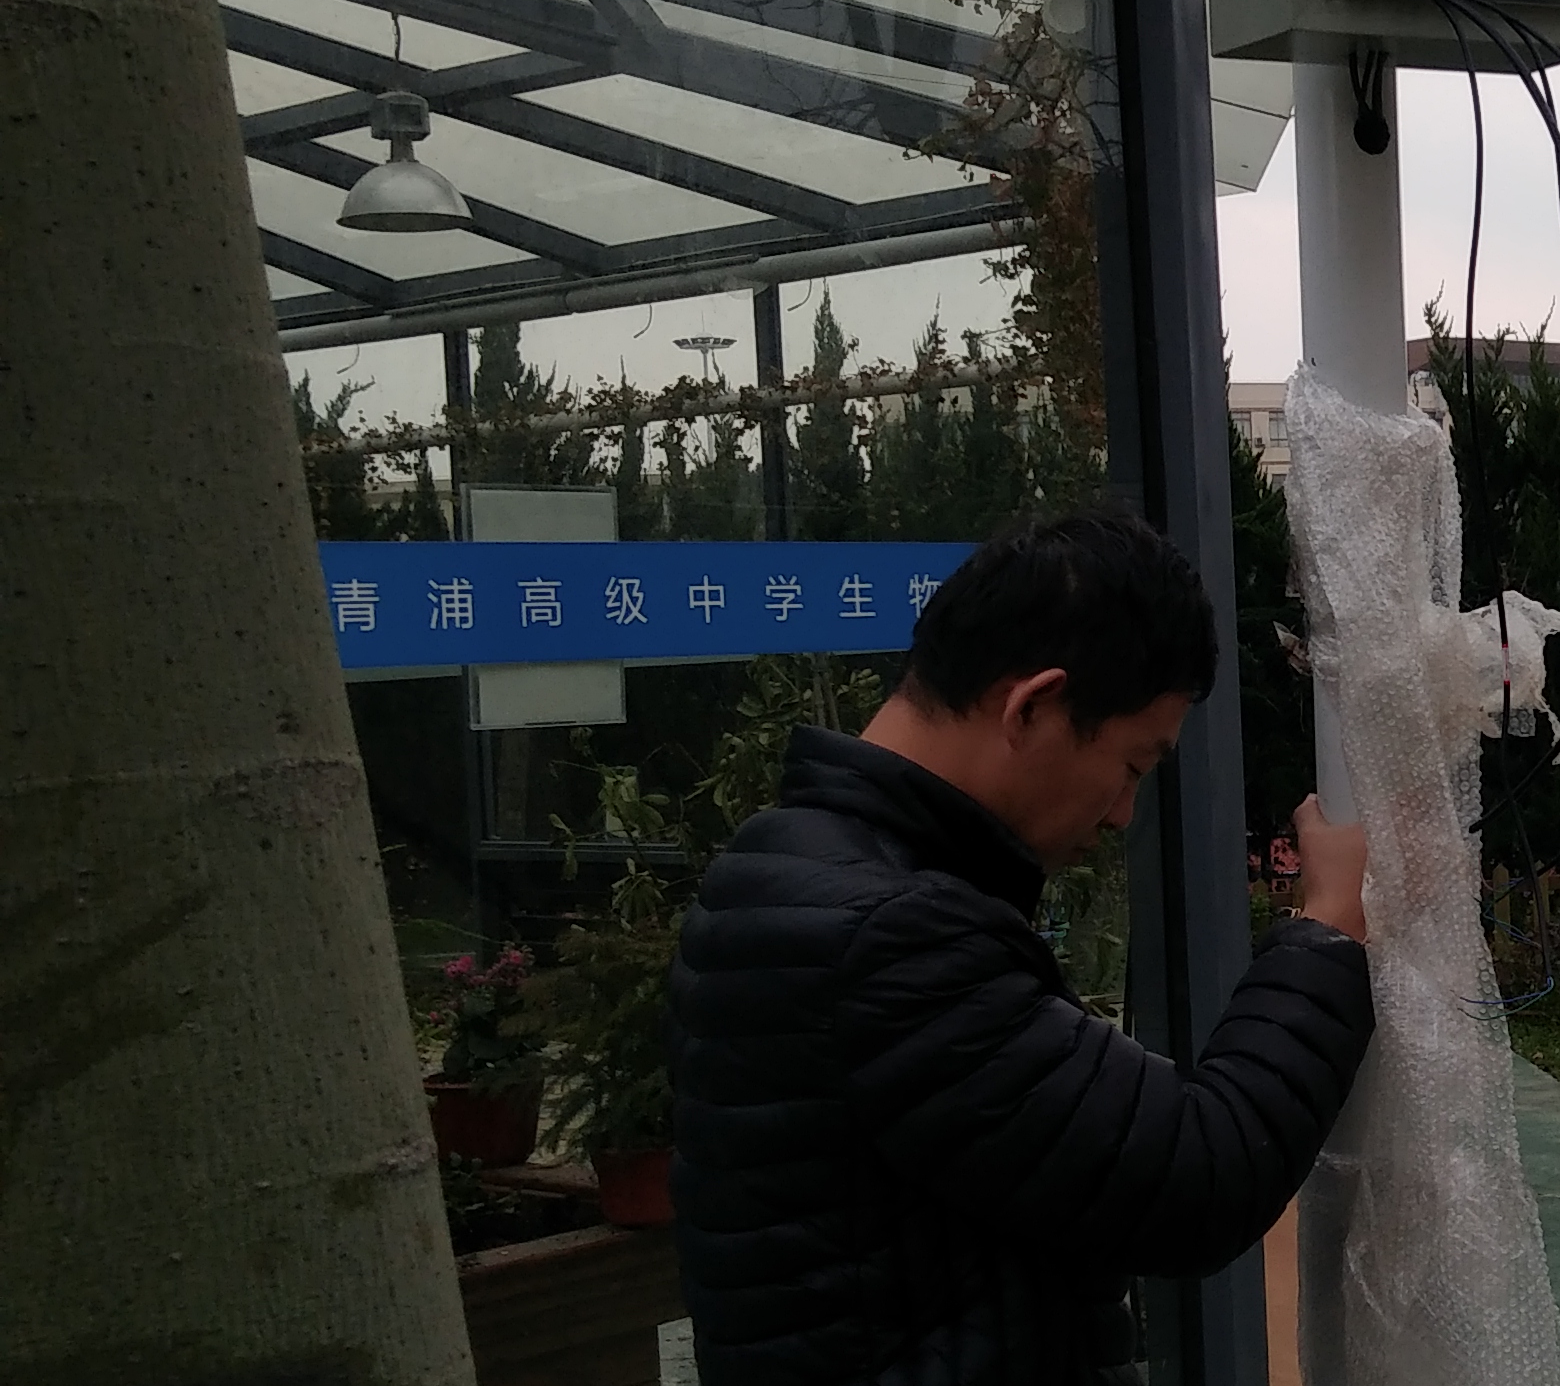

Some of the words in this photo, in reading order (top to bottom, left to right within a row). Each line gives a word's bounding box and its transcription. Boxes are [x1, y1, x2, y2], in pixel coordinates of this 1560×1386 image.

[331, 573, 943, 632] 青浦高级中学生物
